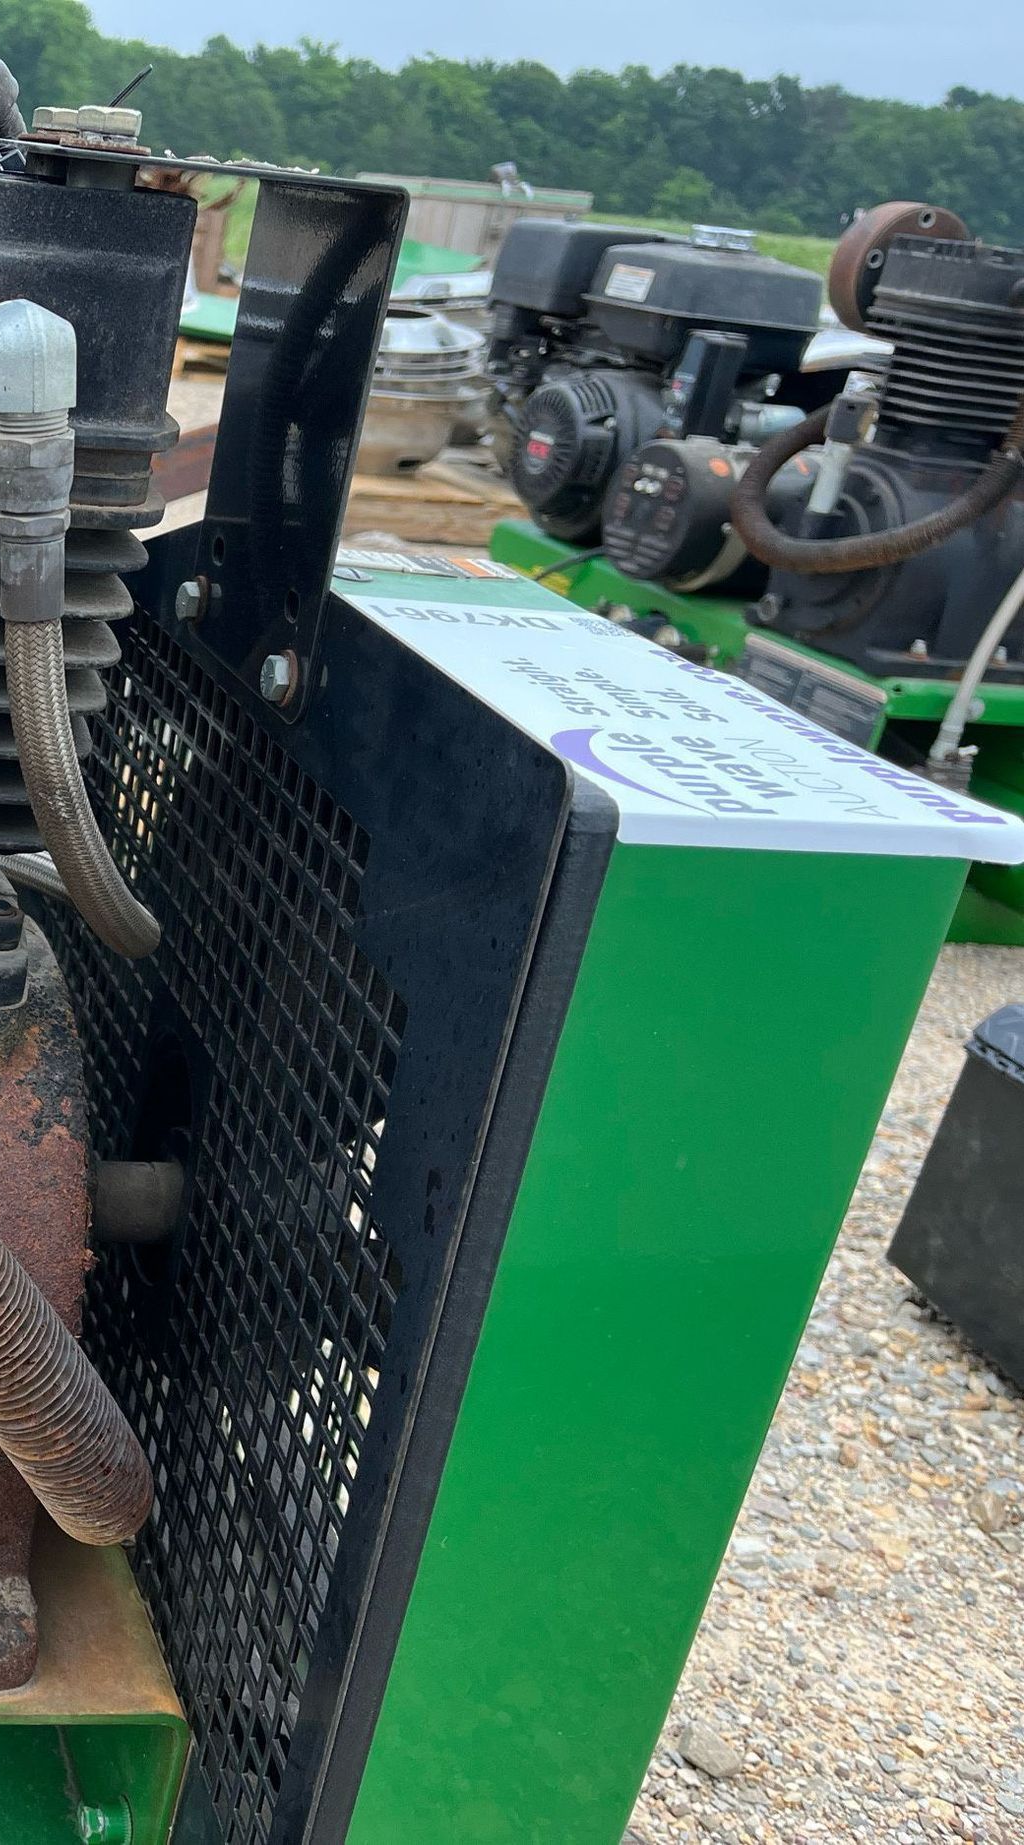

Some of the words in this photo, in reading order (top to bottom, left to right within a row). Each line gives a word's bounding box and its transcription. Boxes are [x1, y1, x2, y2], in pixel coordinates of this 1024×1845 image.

[370, 605, 563, 631] DK7961
[501, 657, 611, 717] Straight.
[575, 667, 670, 720] Simple.
[643, 687, 729, 723] Sold.
[608, 732, 779, 814] purple
[671, 735, 798, 798] wave
[724, 738, 899, 819] AUCTION
